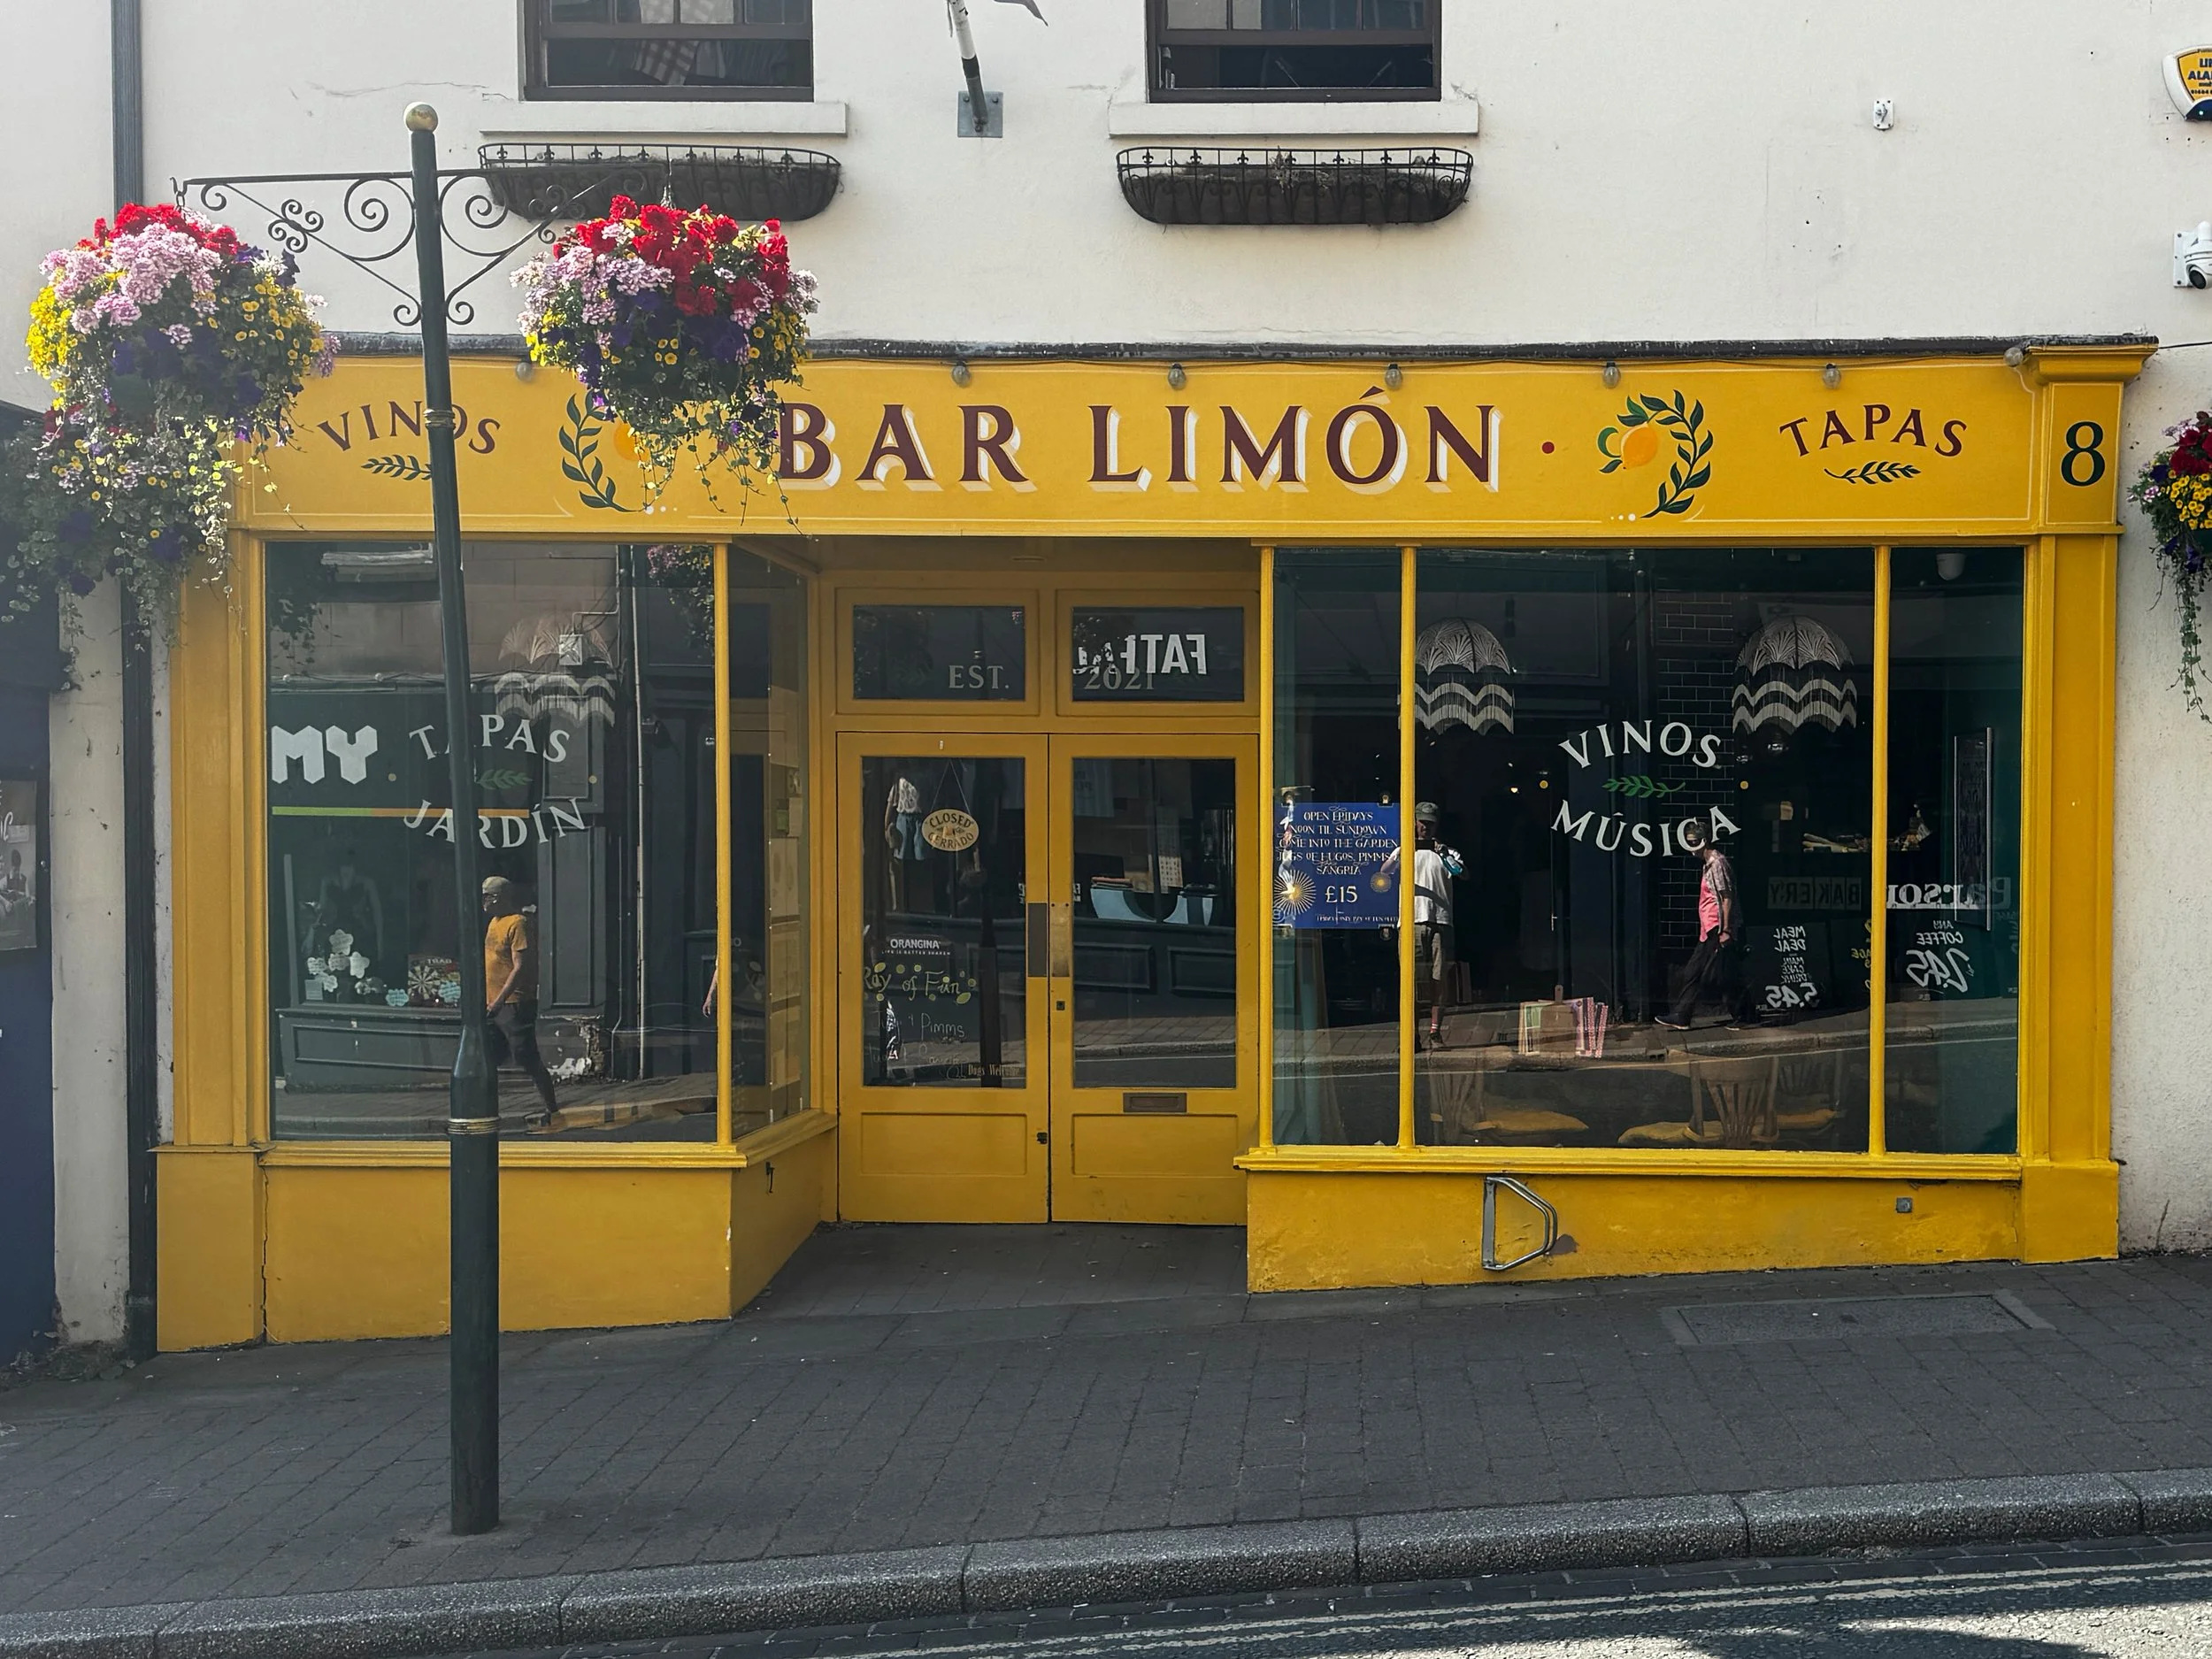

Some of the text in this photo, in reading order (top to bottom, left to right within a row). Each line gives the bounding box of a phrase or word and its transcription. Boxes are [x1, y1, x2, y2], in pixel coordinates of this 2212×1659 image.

[2188, 71, 2212, 80] ALA
[1779, 403, 1968, 457] TAPAS
[779, 386, 1502, 494] BAR LIMÓN
[2061, 421, 2106, 488] 8
[949, 665, 1010, 689] EST.
[409, 714, 570, 763] TPAS
[1558, 719, 1721, 768] VINOS
[929, 812, 972, 827] CLOSED
[1303, 811, 1330, 821] OPEN
[1290, 825, 1314, 834] NOON
[1335, 825, 1387, 835] SUNDOWN
[1550, 799, 1741, 857] MÚSICA
[928, 832, 974, 849] CERRADO
[1309, 839, 1330, 848] INTO
[1333, 839, 1353, 848] THE
[1355, 839, 1398, 849] GARDEN
[1277, 852, 1302, 862] JGS
[1316, 865, 1362, 875] SANGRIA
[1325, 886, 1358, 903] £15
[890, 939, 940, 949] ORANGINA
[863, 965, 961, 1002] Ray of Fun
